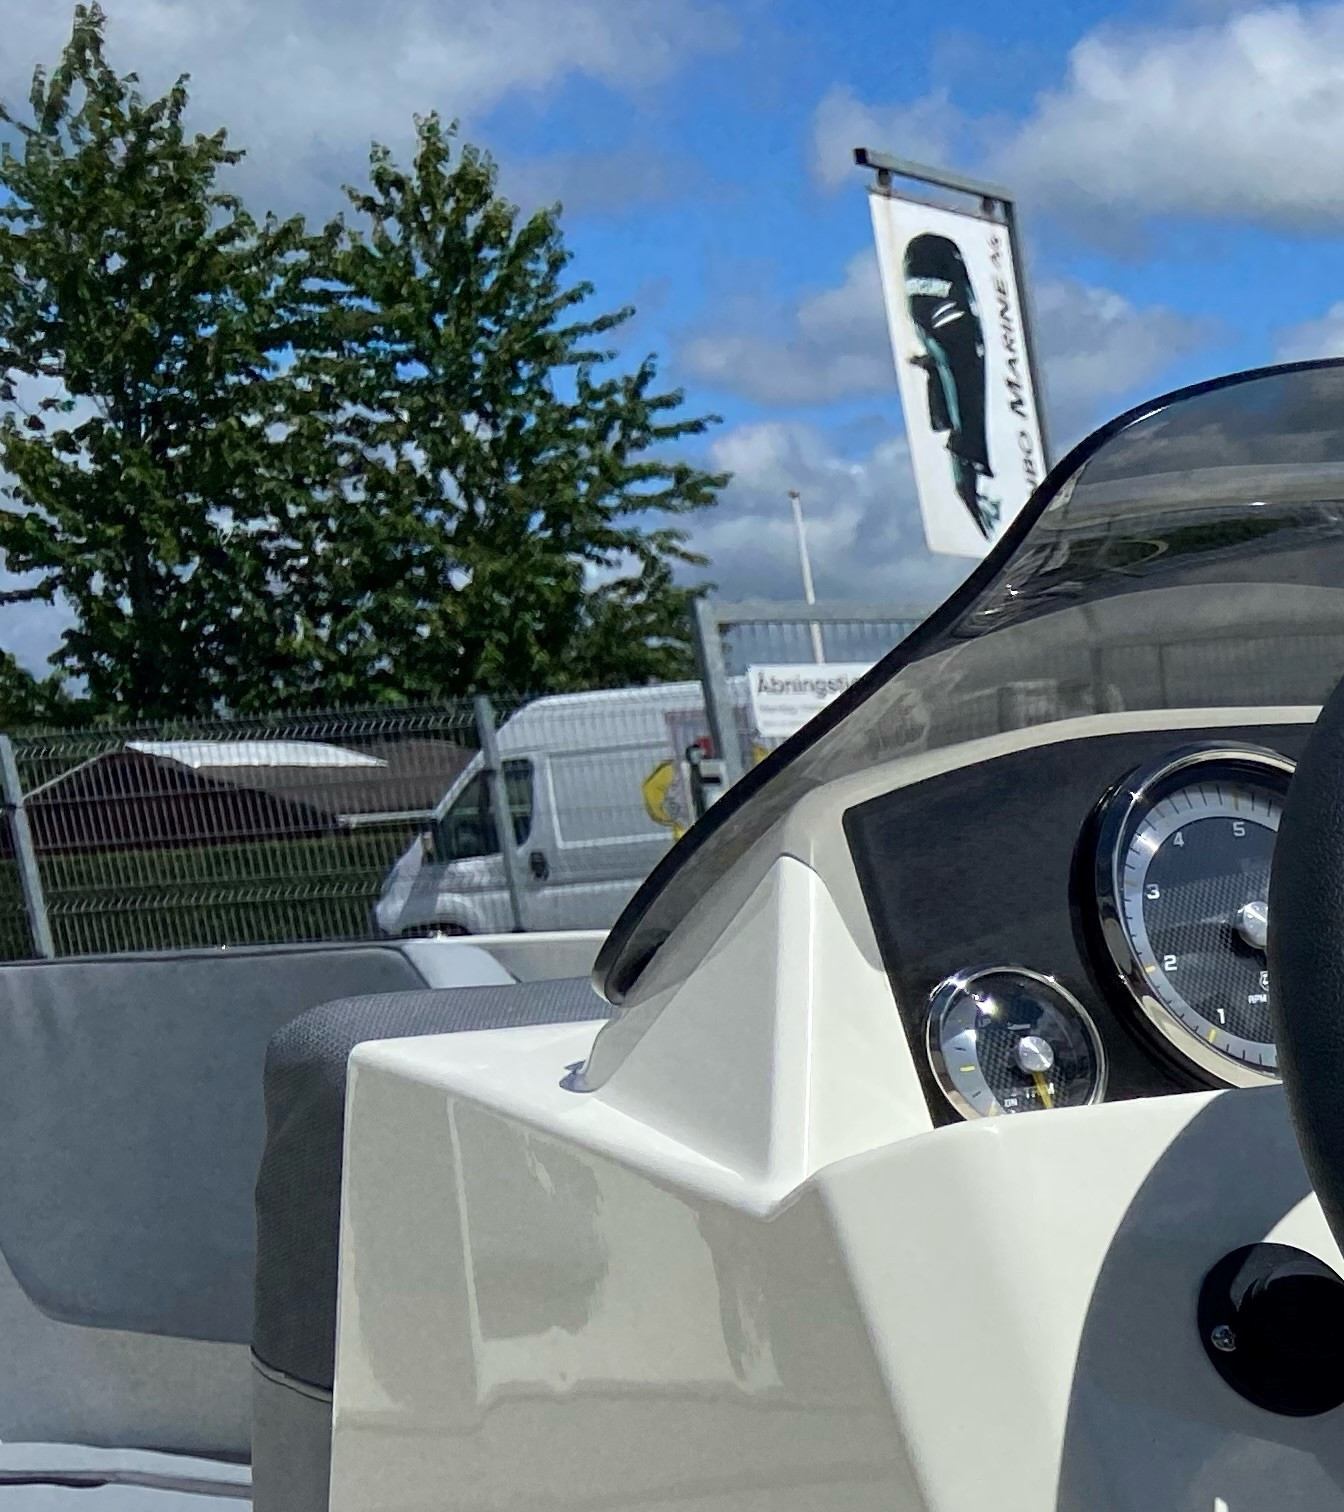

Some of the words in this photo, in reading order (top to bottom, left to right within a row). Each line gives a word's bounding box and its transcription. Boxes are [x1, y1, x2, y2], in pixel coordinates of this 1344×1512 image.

[995, 278, 1026, 418] MARINE
[1232, 821, 1246, 837] 5
[1172, 831, 1185, 848] 4
[1146, 884, 1160, 900] 3
[1164, 955, 1178, 972] 2
[1216, 1008, 1226, 1025] 1
